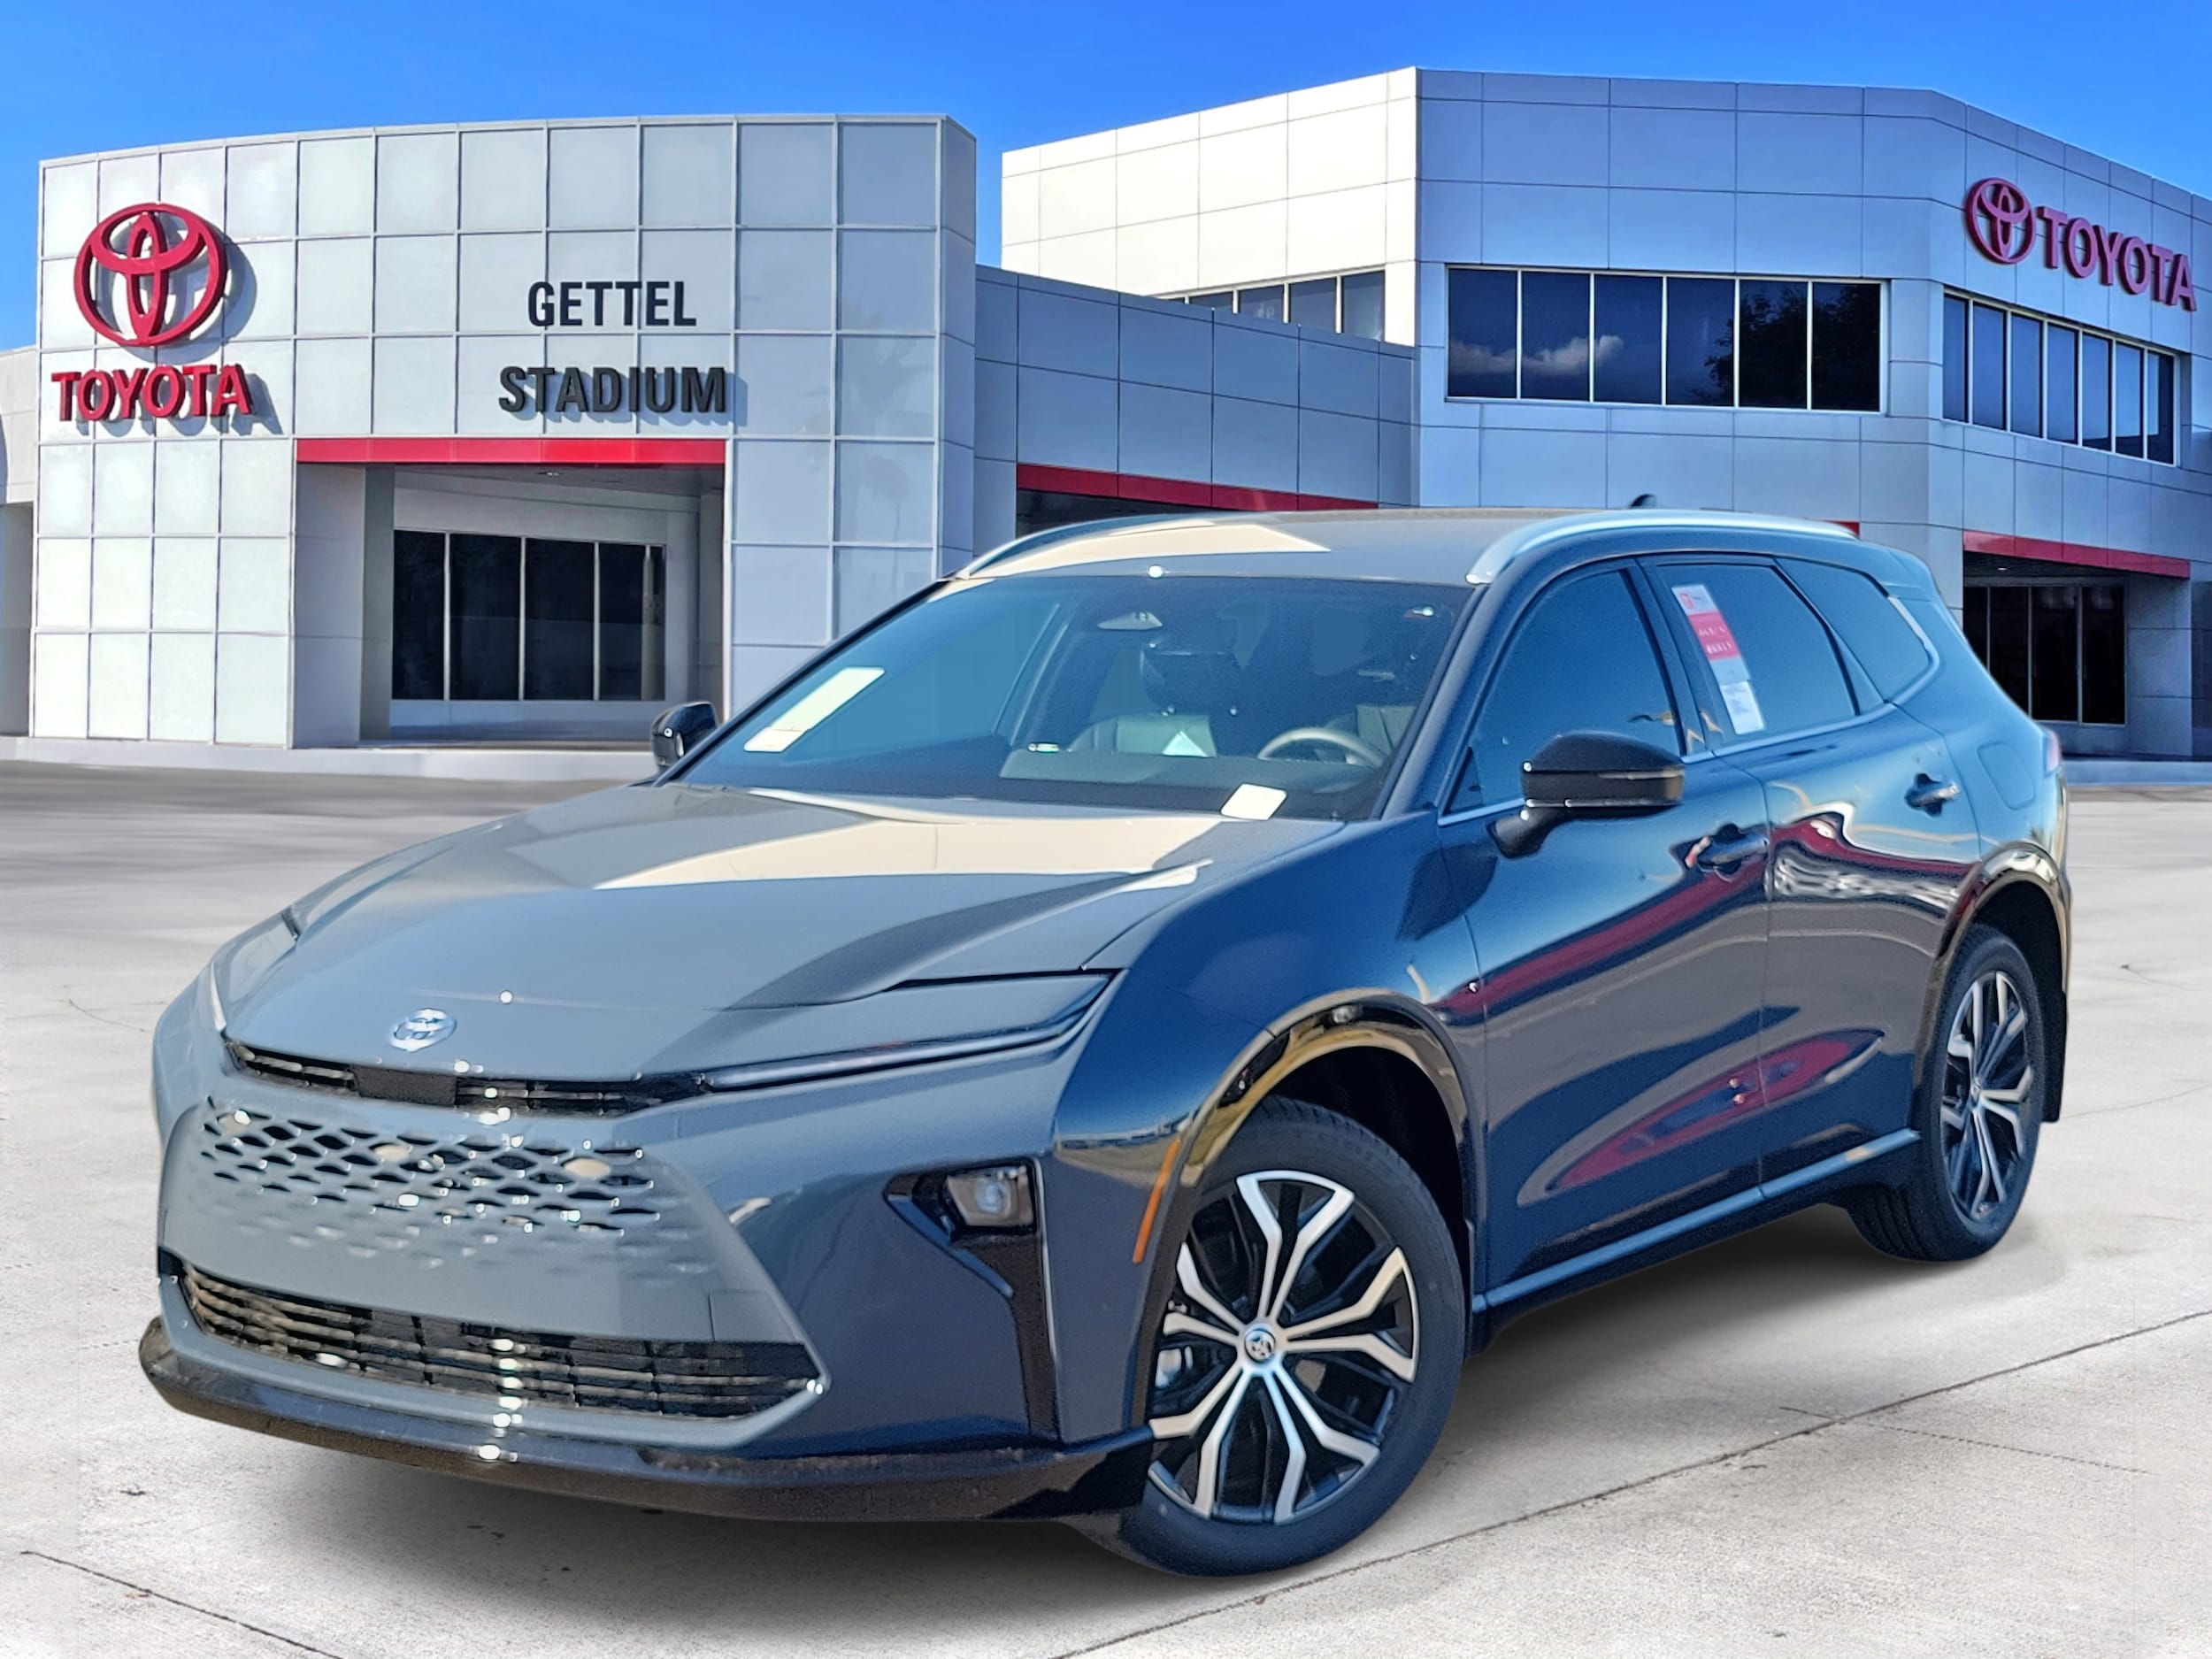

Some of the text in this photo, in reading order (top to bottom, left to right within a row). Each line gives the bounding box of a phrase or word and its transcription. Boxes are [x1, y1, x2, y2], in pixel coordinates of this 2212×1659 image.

[2037, 206, 2197, 311] TOYOTA
[528, 281, 696, 326] GETTEL
[51, 364, 254, 421] TOYOTA
[499, 366, 727, 413] STADIUM
